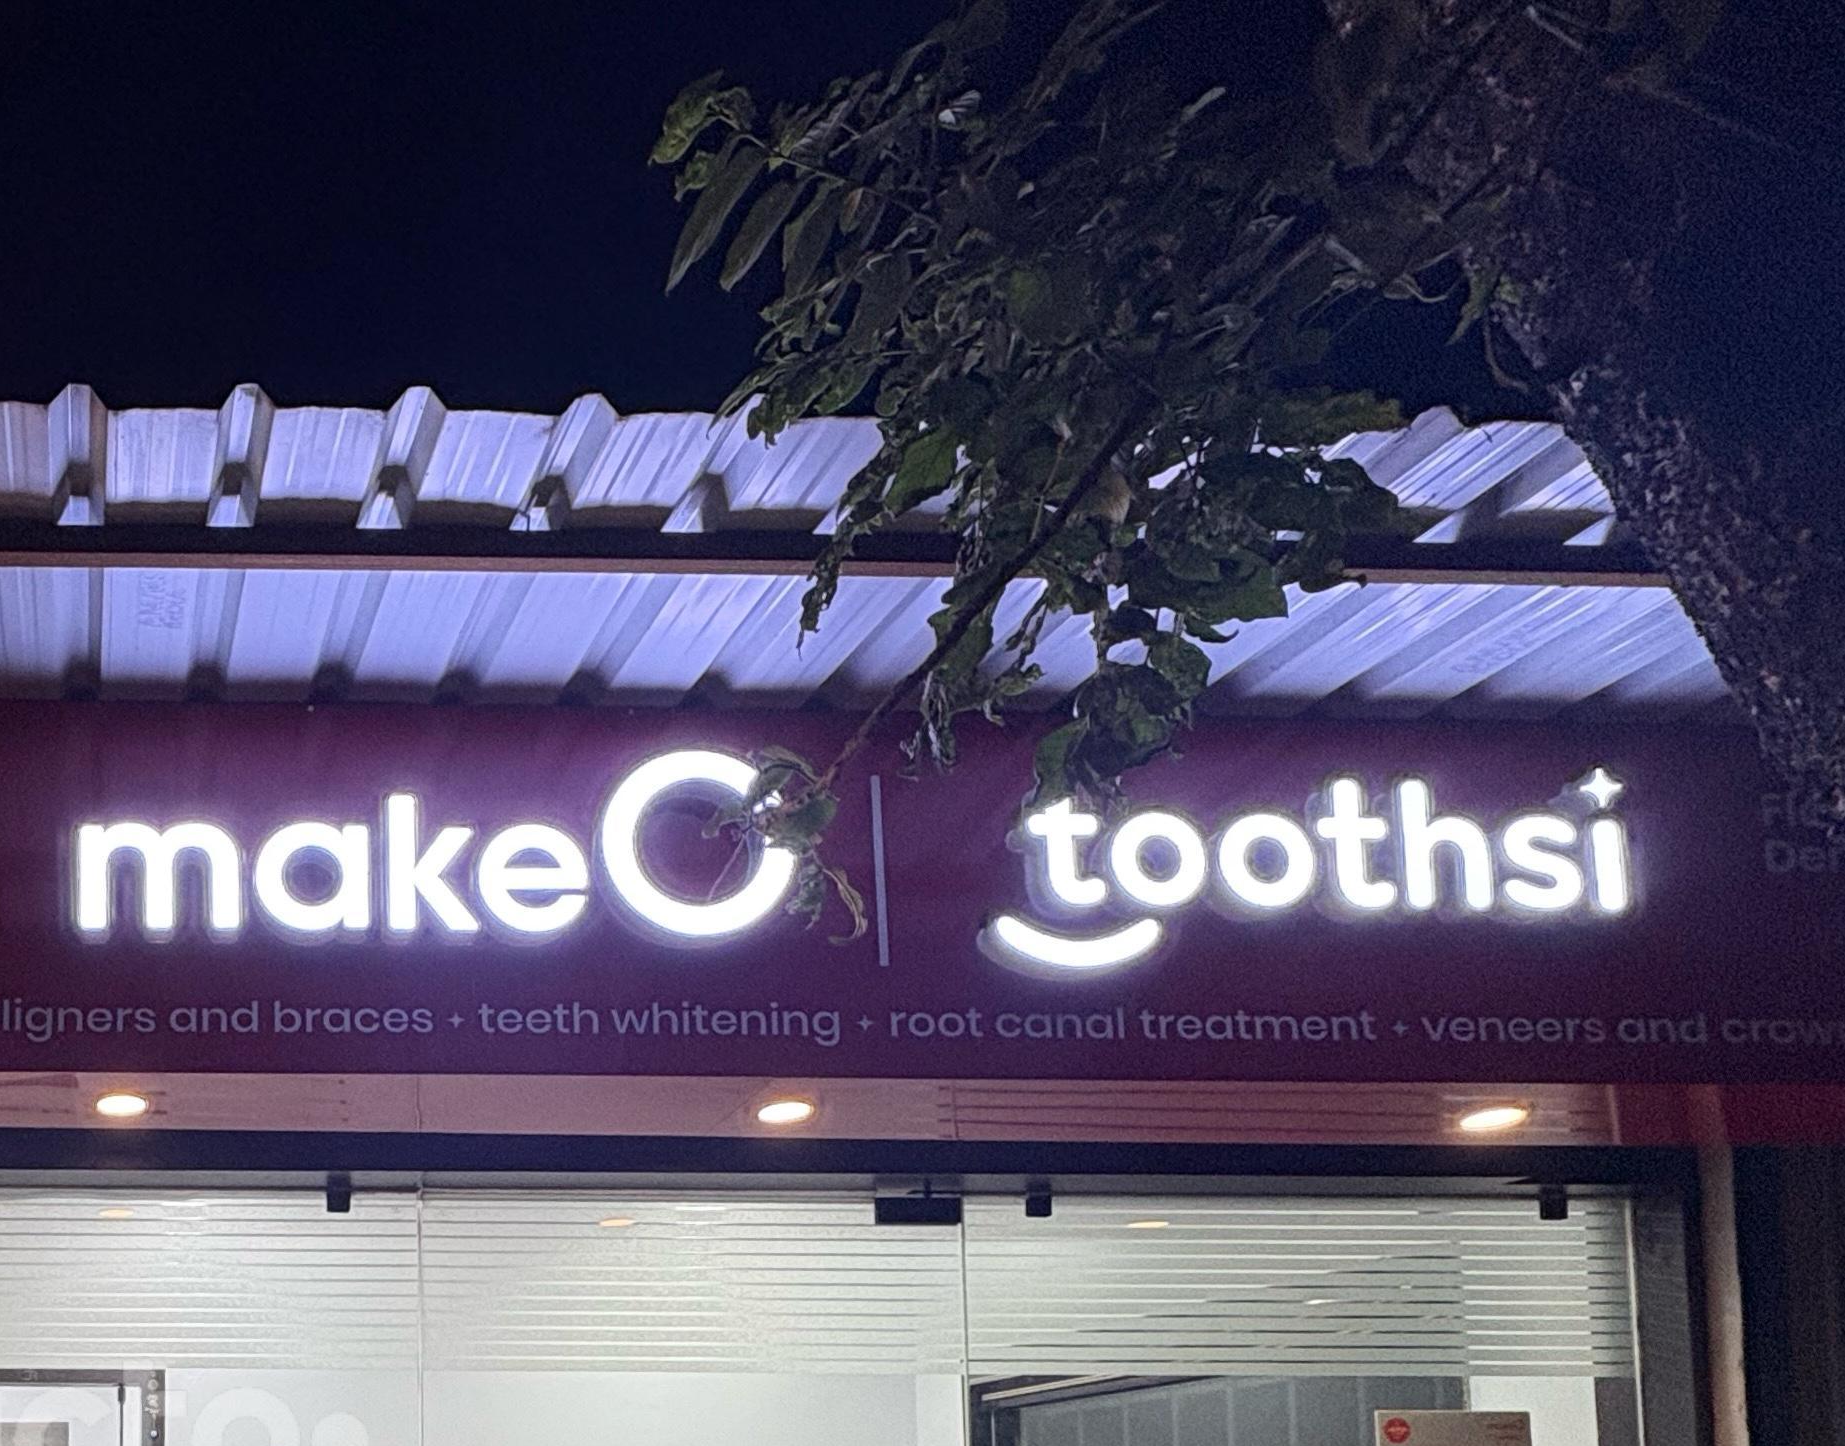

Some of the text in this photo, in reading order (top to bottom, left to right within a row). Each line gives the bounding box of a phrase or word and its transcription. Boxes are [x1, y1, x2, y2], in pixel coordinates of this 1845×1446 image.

[1027, 767, 1629, 911] toothsi
[169, 1000, 258, 1033] and
[274, 1001, 433, 1034] braces
[478, 1002, 598, 1034] teeth
[612, 1002, 840, 1046] whitening
[890, 1007, 983, 1039] root
[996, 1007, 1125, 1039] canal
[1140, 1010, 1377, 1041] treatment
[1420, 1016, 1606, 1043] veneers
[1616, 1012, 1708, 1045] and
